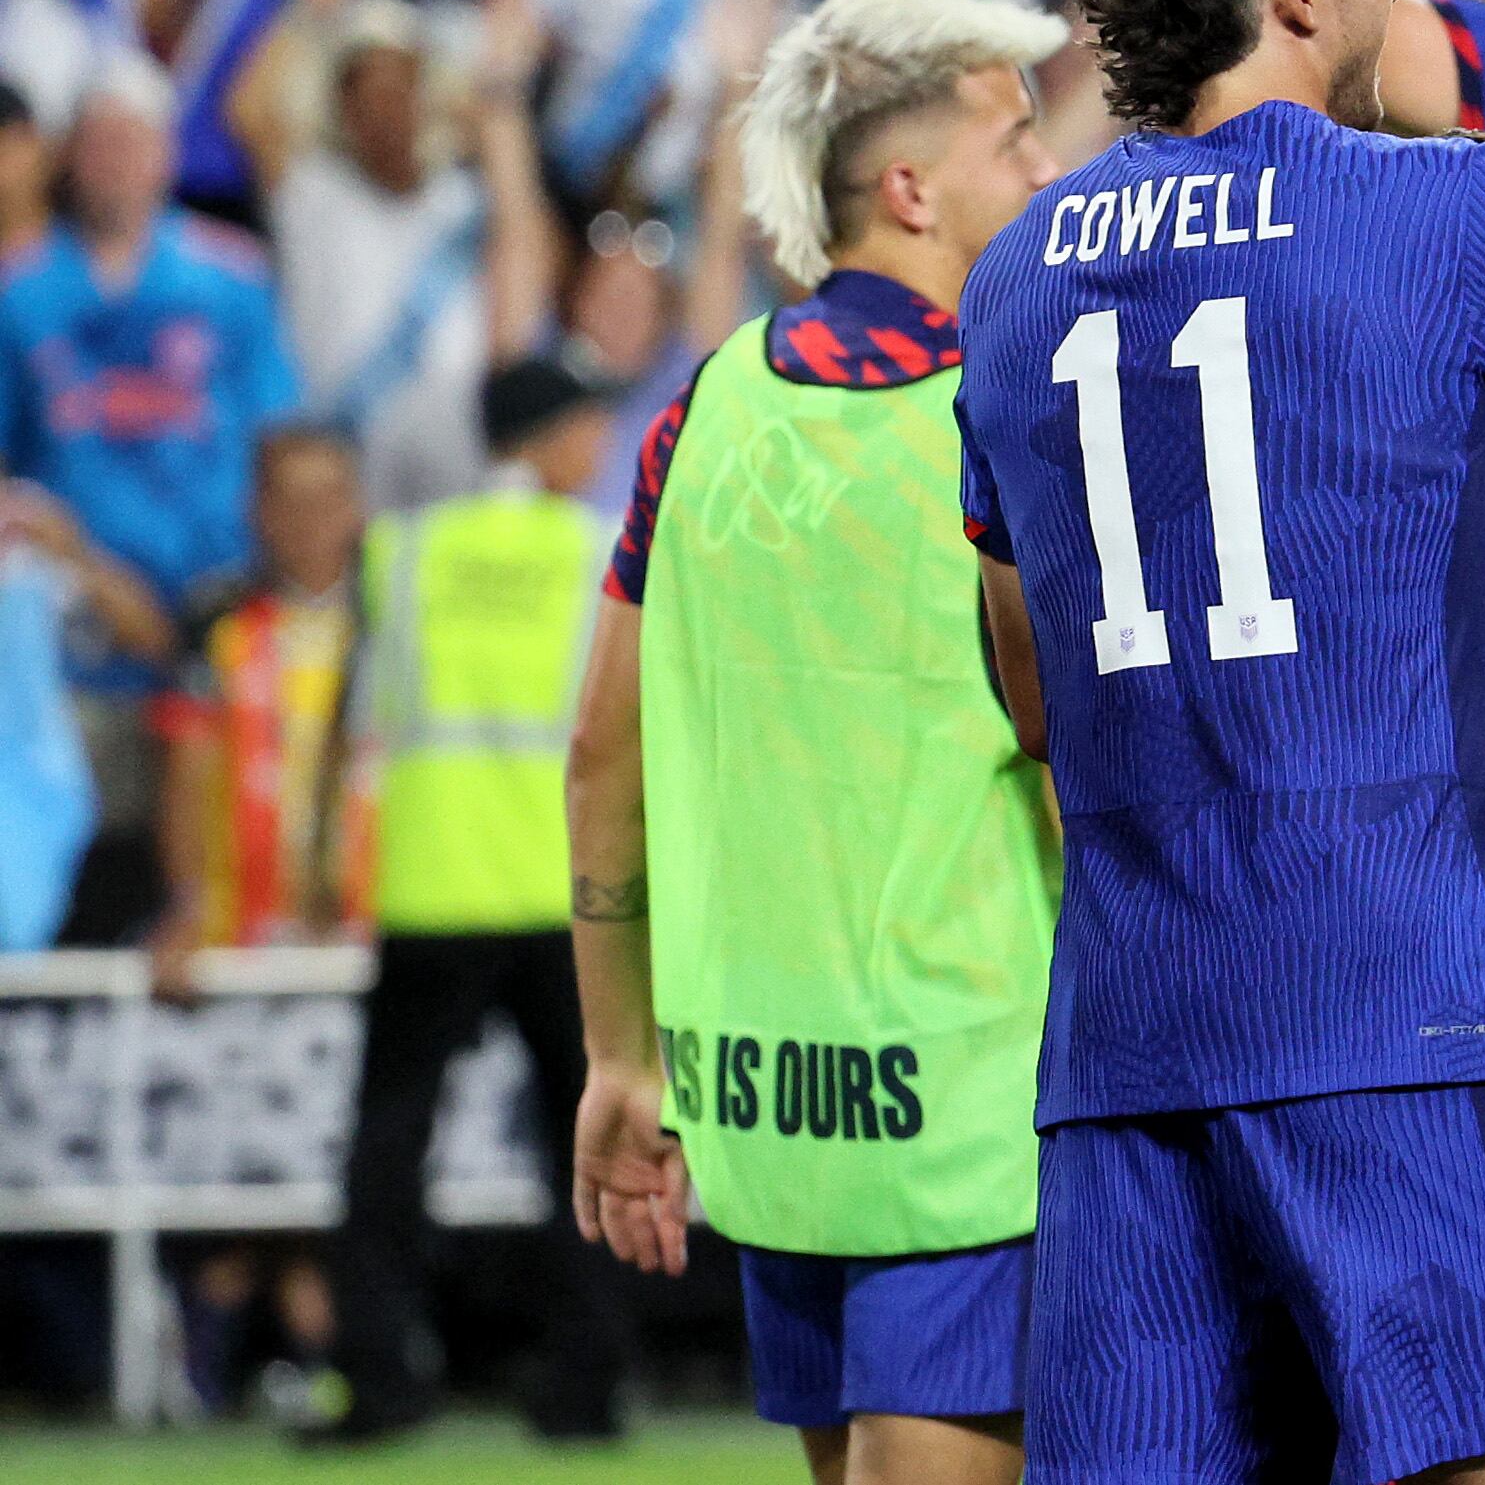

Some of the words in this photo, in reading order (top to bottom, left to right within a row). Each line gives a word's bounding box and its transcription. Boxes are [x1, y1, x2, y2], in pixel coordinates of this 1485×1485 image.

[1044, 167, 1295, 266] COWELL
[1051, 295, 1299, 676] 11
[717, 1035, 761, 1131] IS
[776, 1039, 923, 1141] OURS
